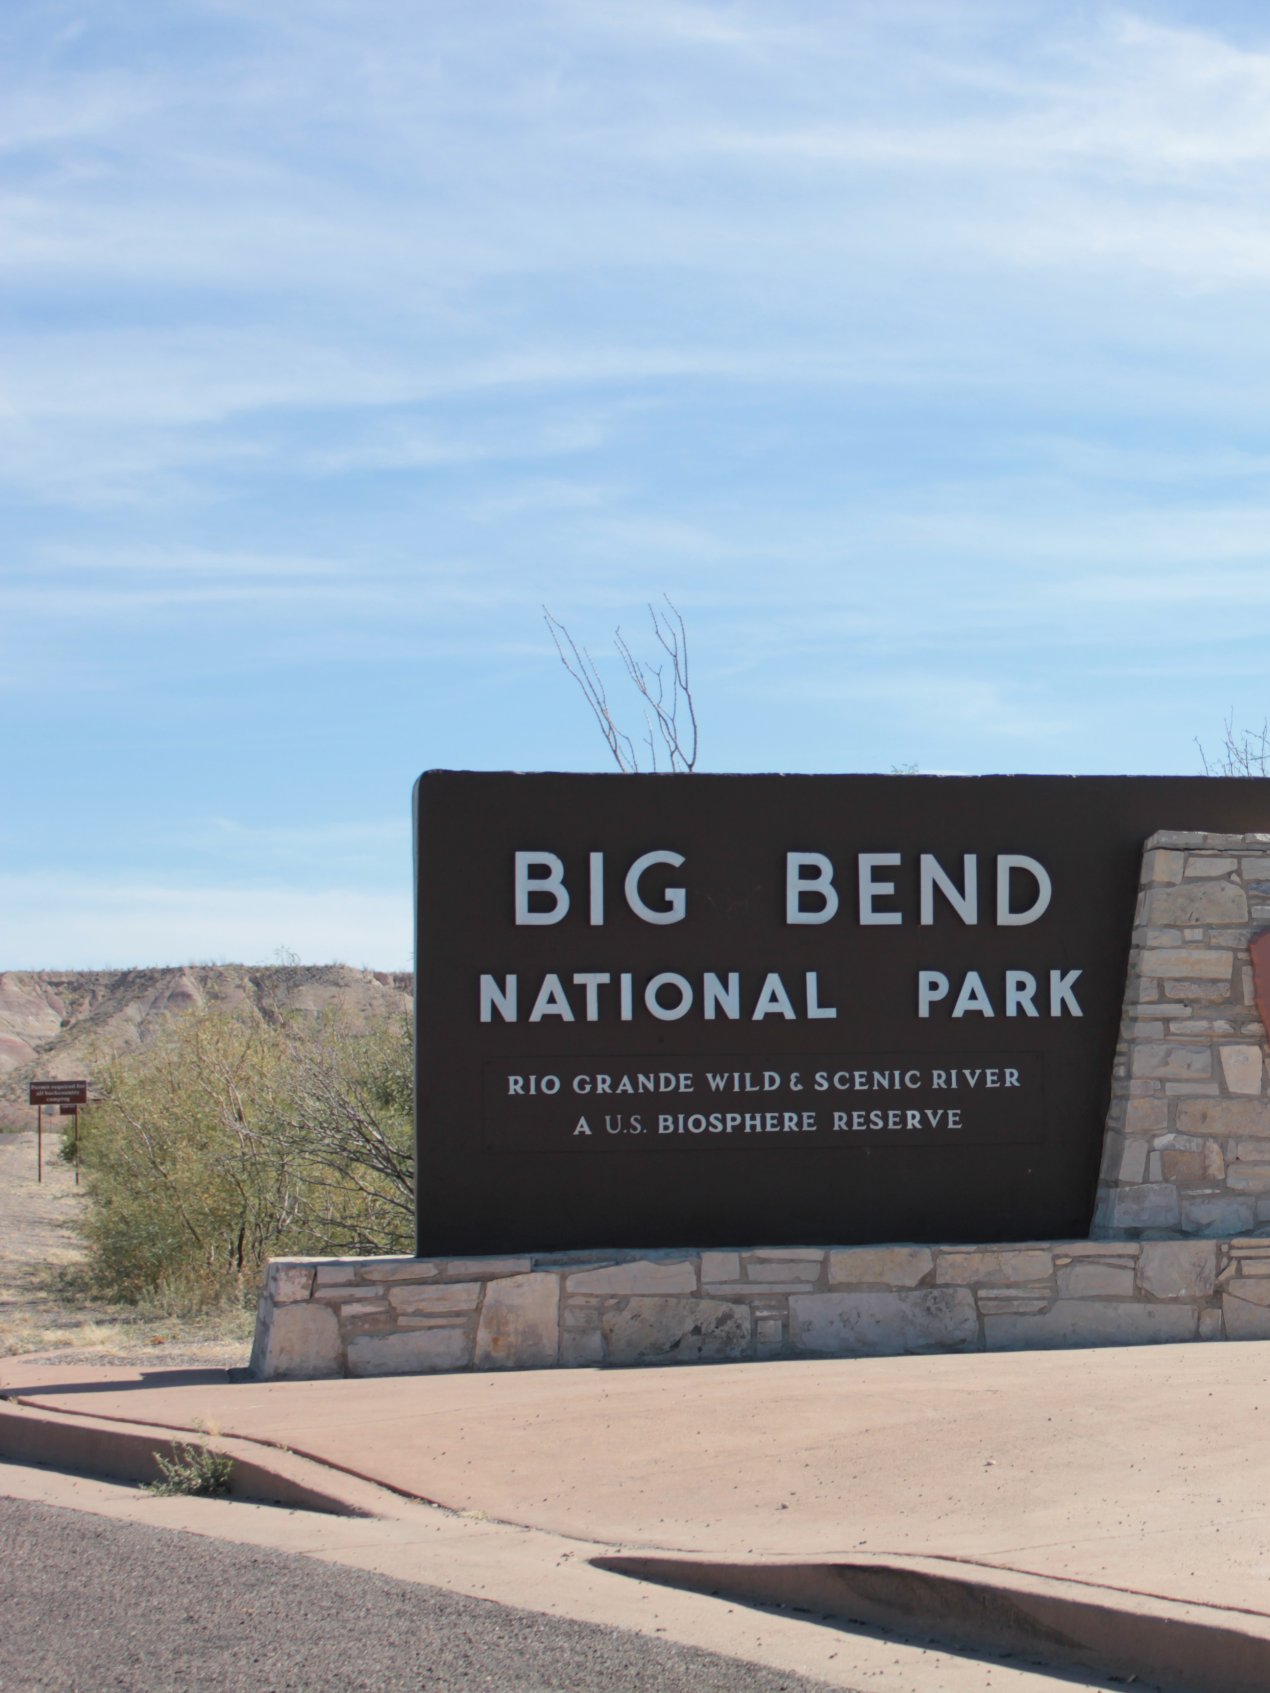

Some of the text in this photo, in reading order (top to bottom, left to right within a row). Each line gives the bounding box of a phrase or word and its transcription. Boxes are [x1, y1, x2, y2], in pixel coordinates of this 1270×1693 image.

[515, 850, 1052, 926] BIG BEND
[480, 969, 1083, 1023] NATIONAL PARK
[507, 1068, 1021, 1095] RIO GRANDE WILD & SCENIC RIVER
[572, 1109, 963, 1136] A U.S. BIOSPHERE RESERVE
